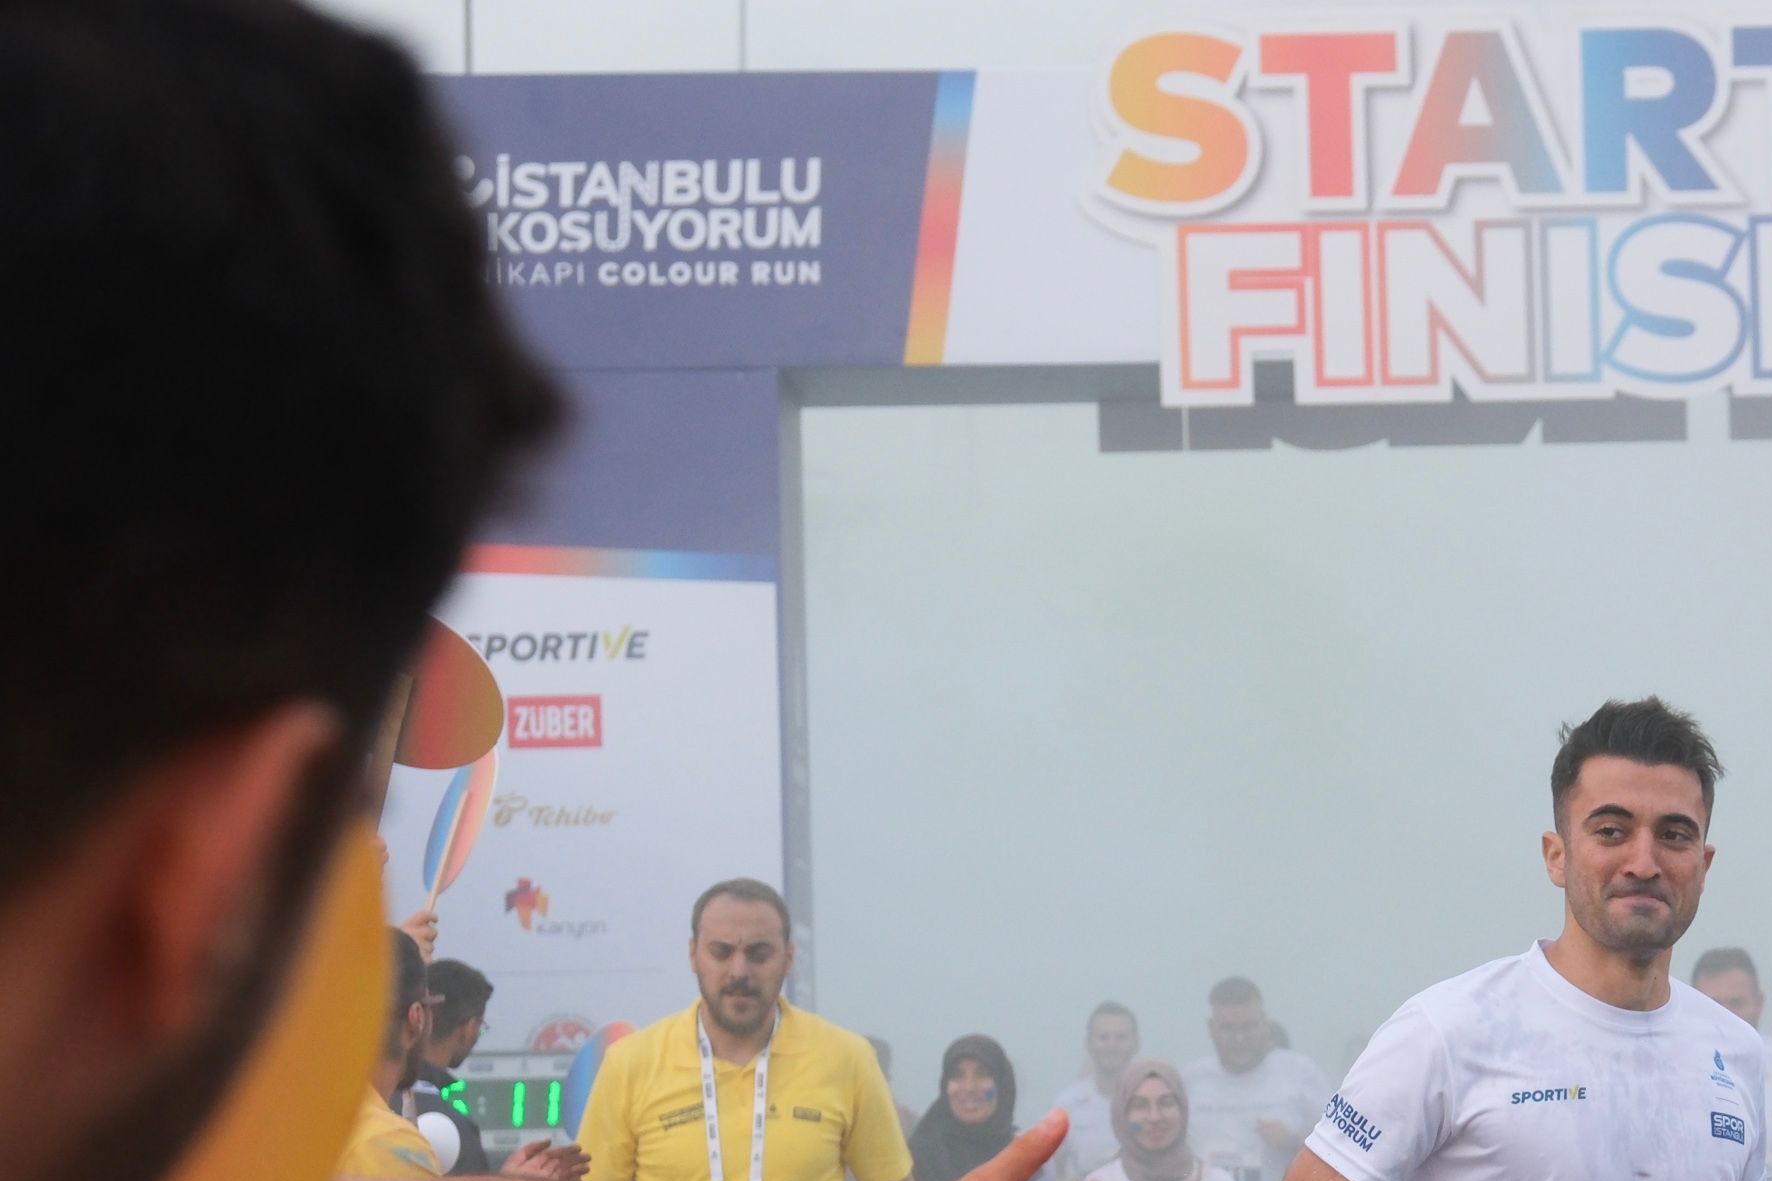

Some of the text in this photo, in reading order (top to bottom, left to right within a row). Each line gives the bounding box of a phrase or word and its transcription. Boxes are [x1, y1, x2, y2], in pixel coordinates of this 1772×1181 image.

[496, 153, 822, 208] İSTANBULU
[598, 259, 740, 287] COLOUR
[750, 260, 822, 285] RUN
[466, 625, 649, 662] PORTIVE
[1511, 1086, 1587, 1104] SPORTIVE
[1713, 1114, 1744, 1133] SPOR
